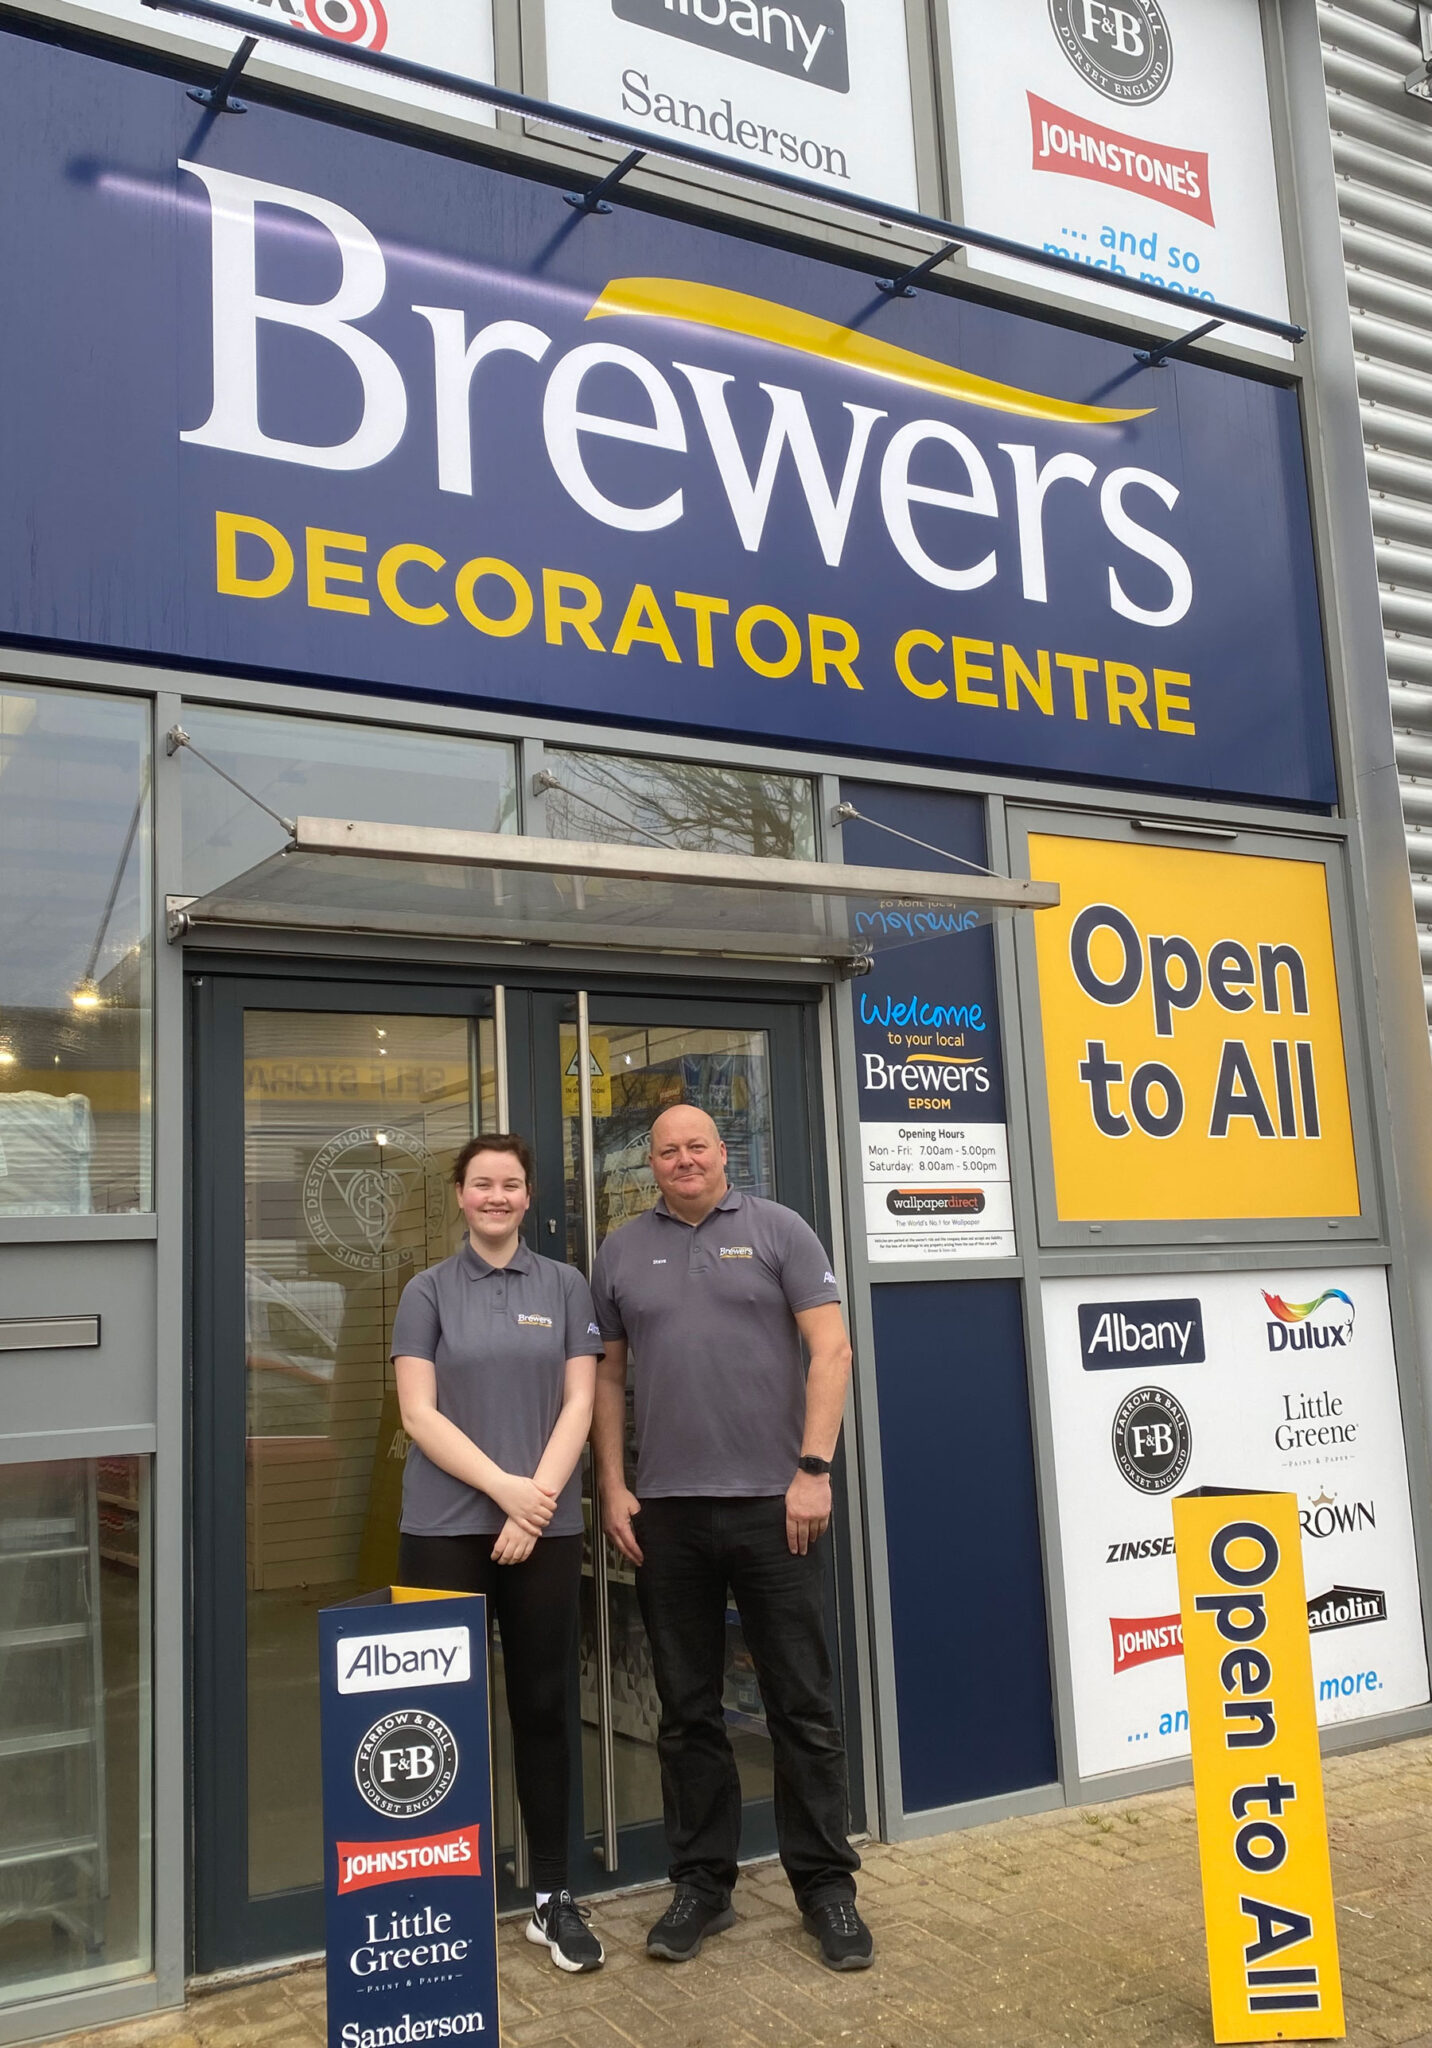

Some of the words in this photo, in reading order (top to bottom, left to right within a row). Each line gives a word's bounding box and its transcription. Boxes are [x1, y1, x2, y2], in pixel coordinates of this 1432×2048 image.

[664, 0, 826, 72] bany
[1082, 0, 1144, 57] F&B
[1060, 26, 1109, 88] DORSET
[1114, 61, 1164, 96] ENGLAND
[621, 69, 851, 179] Sanderson
[1039, 120, 1201, 199] JOHNSTONE'S
[1099, 225, 1158, 262] and
[1167, 246, 1201, 274] so
[177, 158, 1193, 627] Brewers
[216, 510, 864, 691] DECORATOR
[894, 629, 1196, 736] CENTRE
[1069, 903, 1310, 1038] Open
[860, 992, 987, 1031] Welcome
[888, 1031, 902, 1044] to
[905, 1034, 933, 1048] your
[936, 1032, 965, 1047] local
[862, 1053, 990, 1092] Brewers
[1078, 1039, 1185, 1140] to
[1208, 1039, 1321, 1140] All
[908, 1098, 951, 1110] EPSOM
[868, 1145, 889, 1155] Mon
[919, 1145, 953, 1155] 7.00am
[961, 1145, 996, 1158] 5.00pm
[898, 1128, 936, 1141] Opening
[938, 1129, 965, 1139] Hours
[306, 1128, 370, 1209] DESTINATION
[869, 1160, 914, 1173] Saturday:
[919, 1161, 954, 1171] 8.00am
[962, 1161, 998, 1173] 5.00pm
[894, 1195, 978, 1211] wallpaperdirect
[309, 1213, 331, 1245] THE
[334, 1246, 381, 1269] SINCE
[720, 1247, 753, 1256] Brewers
[518, 1313, 552, 1325] Brewers
[1087, 1312, 1192, 1358] Albany
[1266, 1321, 1347, 1352] Dulux
[1117, 1391, 1151, 1436] FARROW
[1165, 1398, 1185, 1430] BALL
[1282, 1390, 1343, 1421] Little
[1131, 1423, 1174, 1458] F&B
[1275, 1423, 1357, 1451] Greene
[1120, 1455, 1152, 1488] DORSET
[1155, 1449, 1187, 1488] ENGLAND
[1106, 1537, 1177, 1563] ZINSSE
[1193, 1520, 1281, 1751] Open
[345, 1644, 458, 1680] Albany
[1319, 1671, 1383, 1701] more.
[360, 1713, 409, 1760] FARROW
[414, 1715, 423, 1725] &
[427, 1720, 452, 1752] BALL
[379, 1745, 435, 1783] F&B
[362, 1780, 401, 1813] DORSET
[406, 1771, 451, 1813] ENGLAND
[1230, 1774, 1298, 1875] to
[343, 1836, 472, 1884] JOHNSTONE'S
[365, 1906, 452, 1944] Little
[350, 1939, 468, 1976] Greene
[1238, 1893, 1322, 2014] All
[341, 2011, 486, 2048] Sanderson
